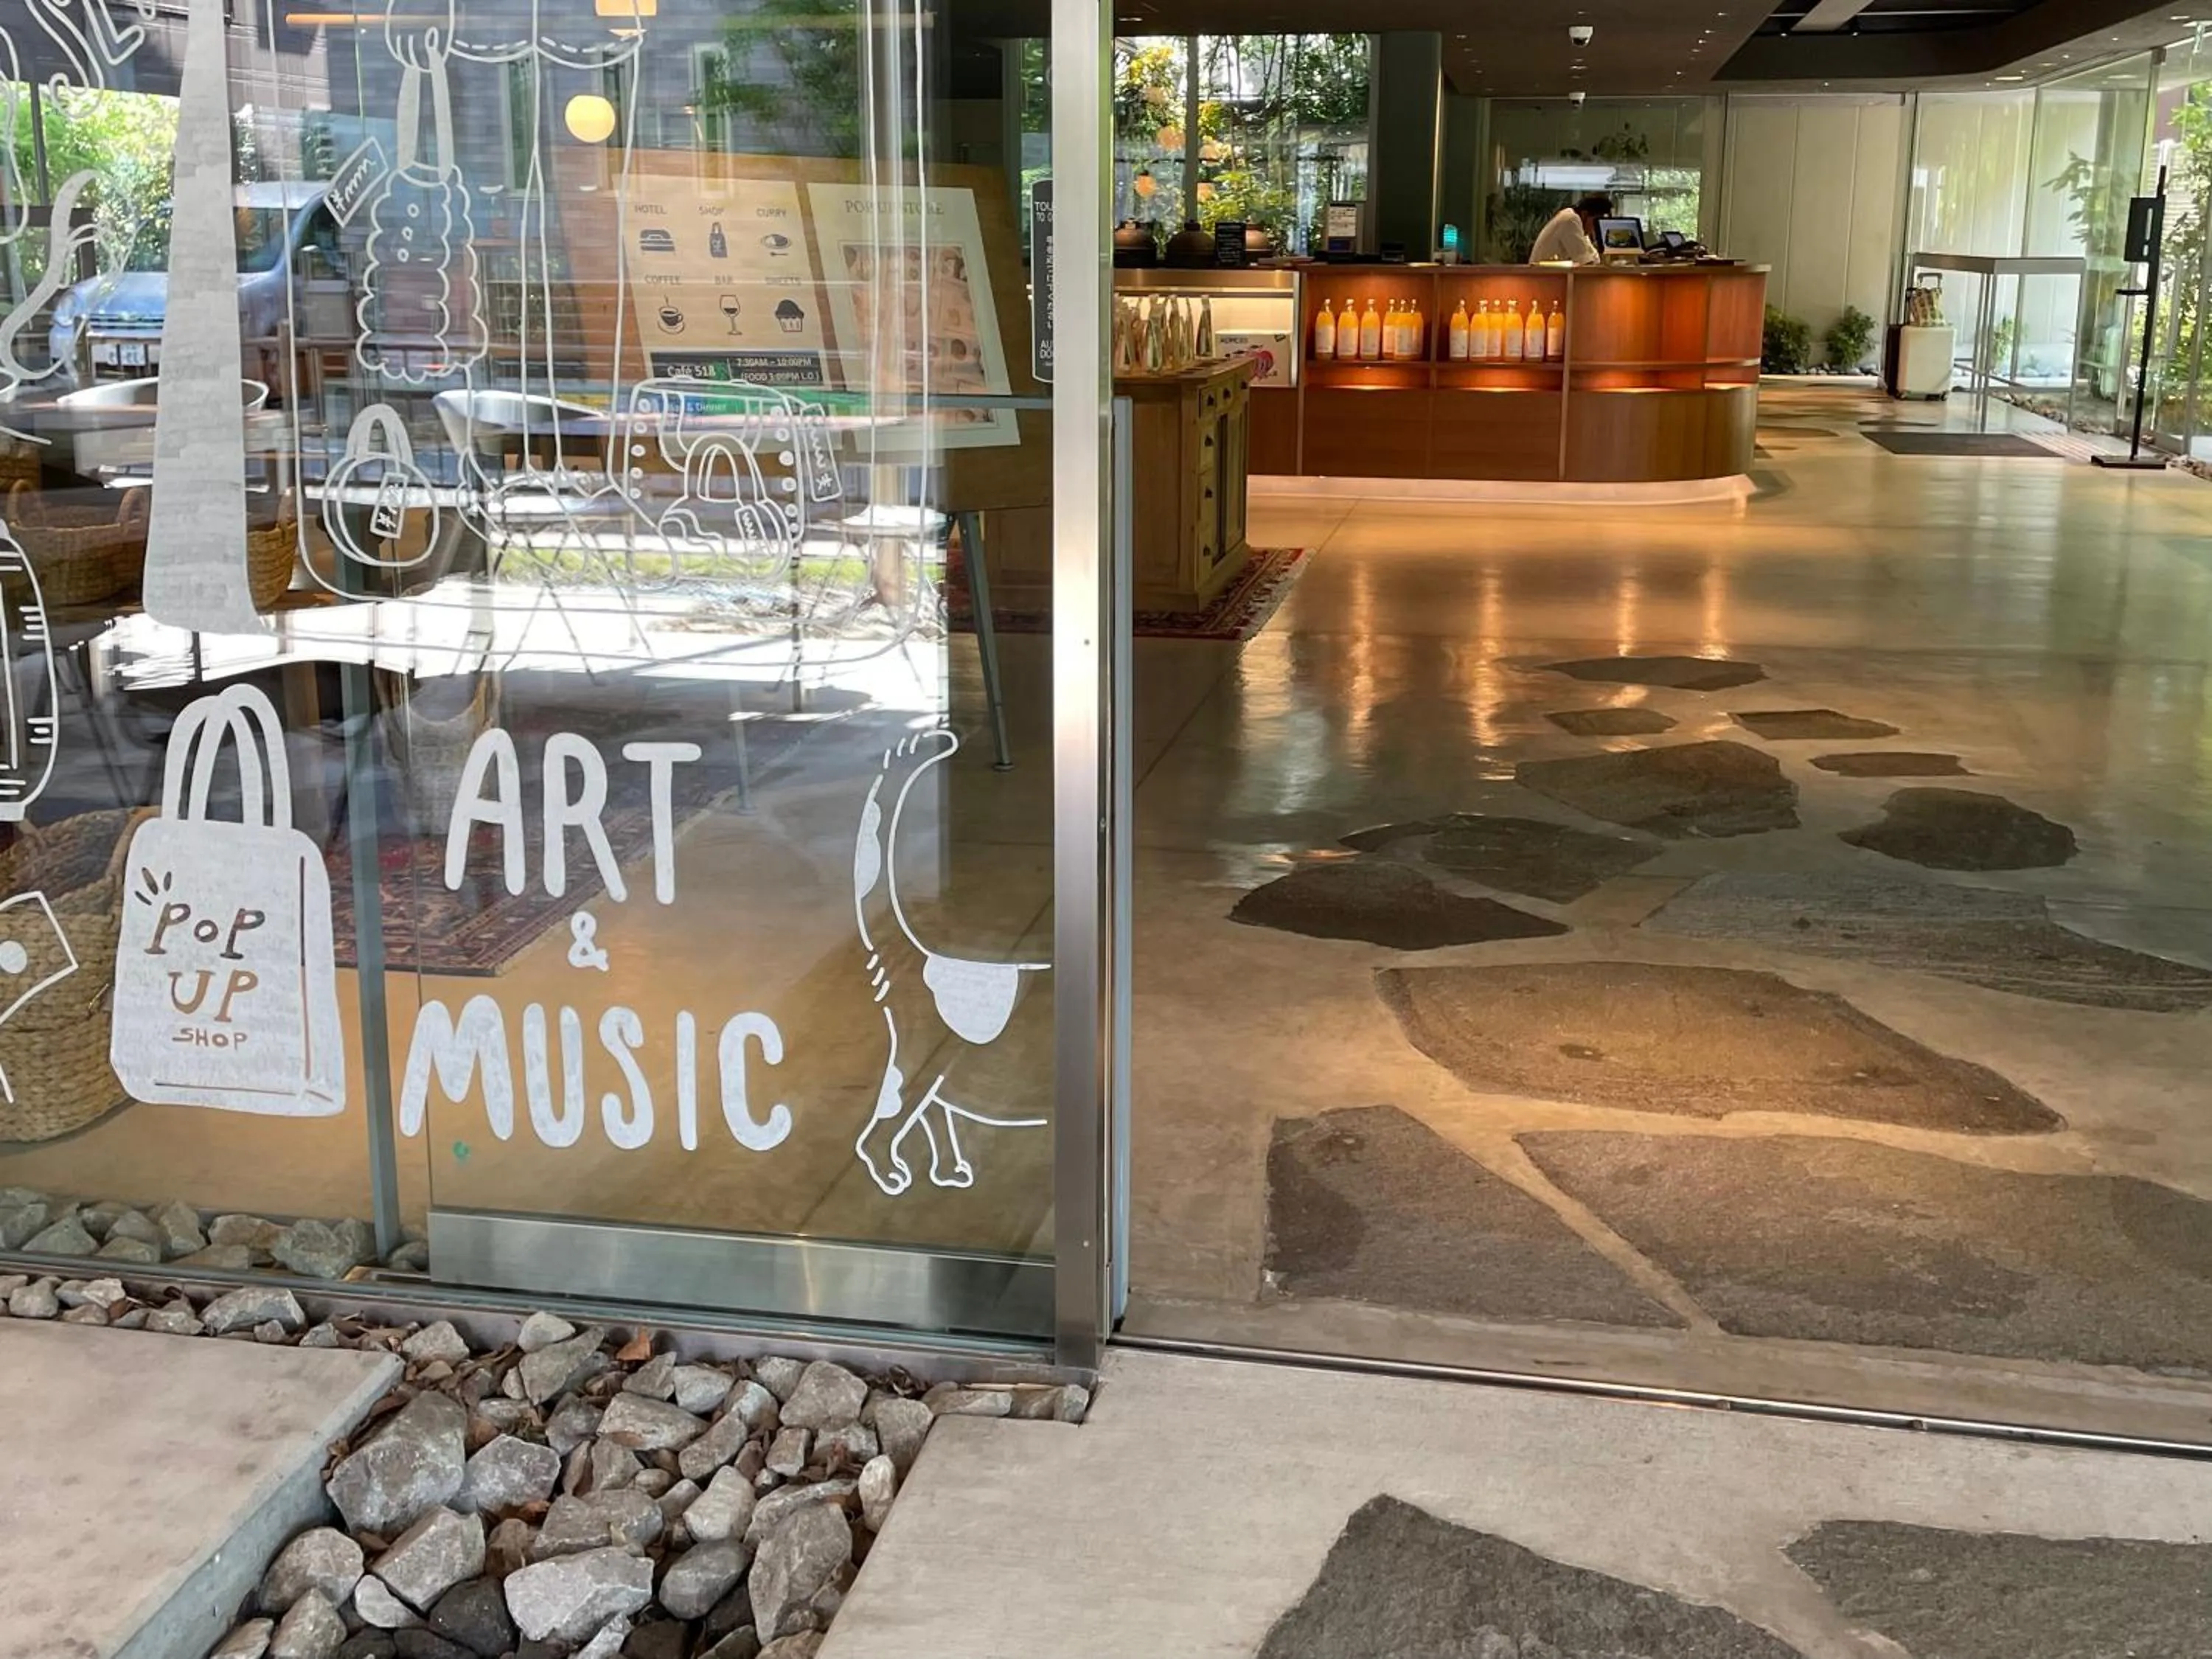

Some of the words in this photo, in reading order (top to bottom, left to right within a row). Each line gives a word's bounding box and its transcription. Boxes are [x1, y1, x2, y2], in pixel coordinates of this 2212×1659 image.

[634, 204, 667, 215] HOTEL
[698, 206, 725, 216] SHOP
[756, 208, 787, 218] CURRY
[644, 274, 682, 286] COFFEE
[444, 727, 703, 905] ART
[567, 911, 610, 972] &
[167, 968, 259, 1023] UP
[171, 1027, 248, 1050] SHOP
[399, 994, 793, 1151] MUSIC
